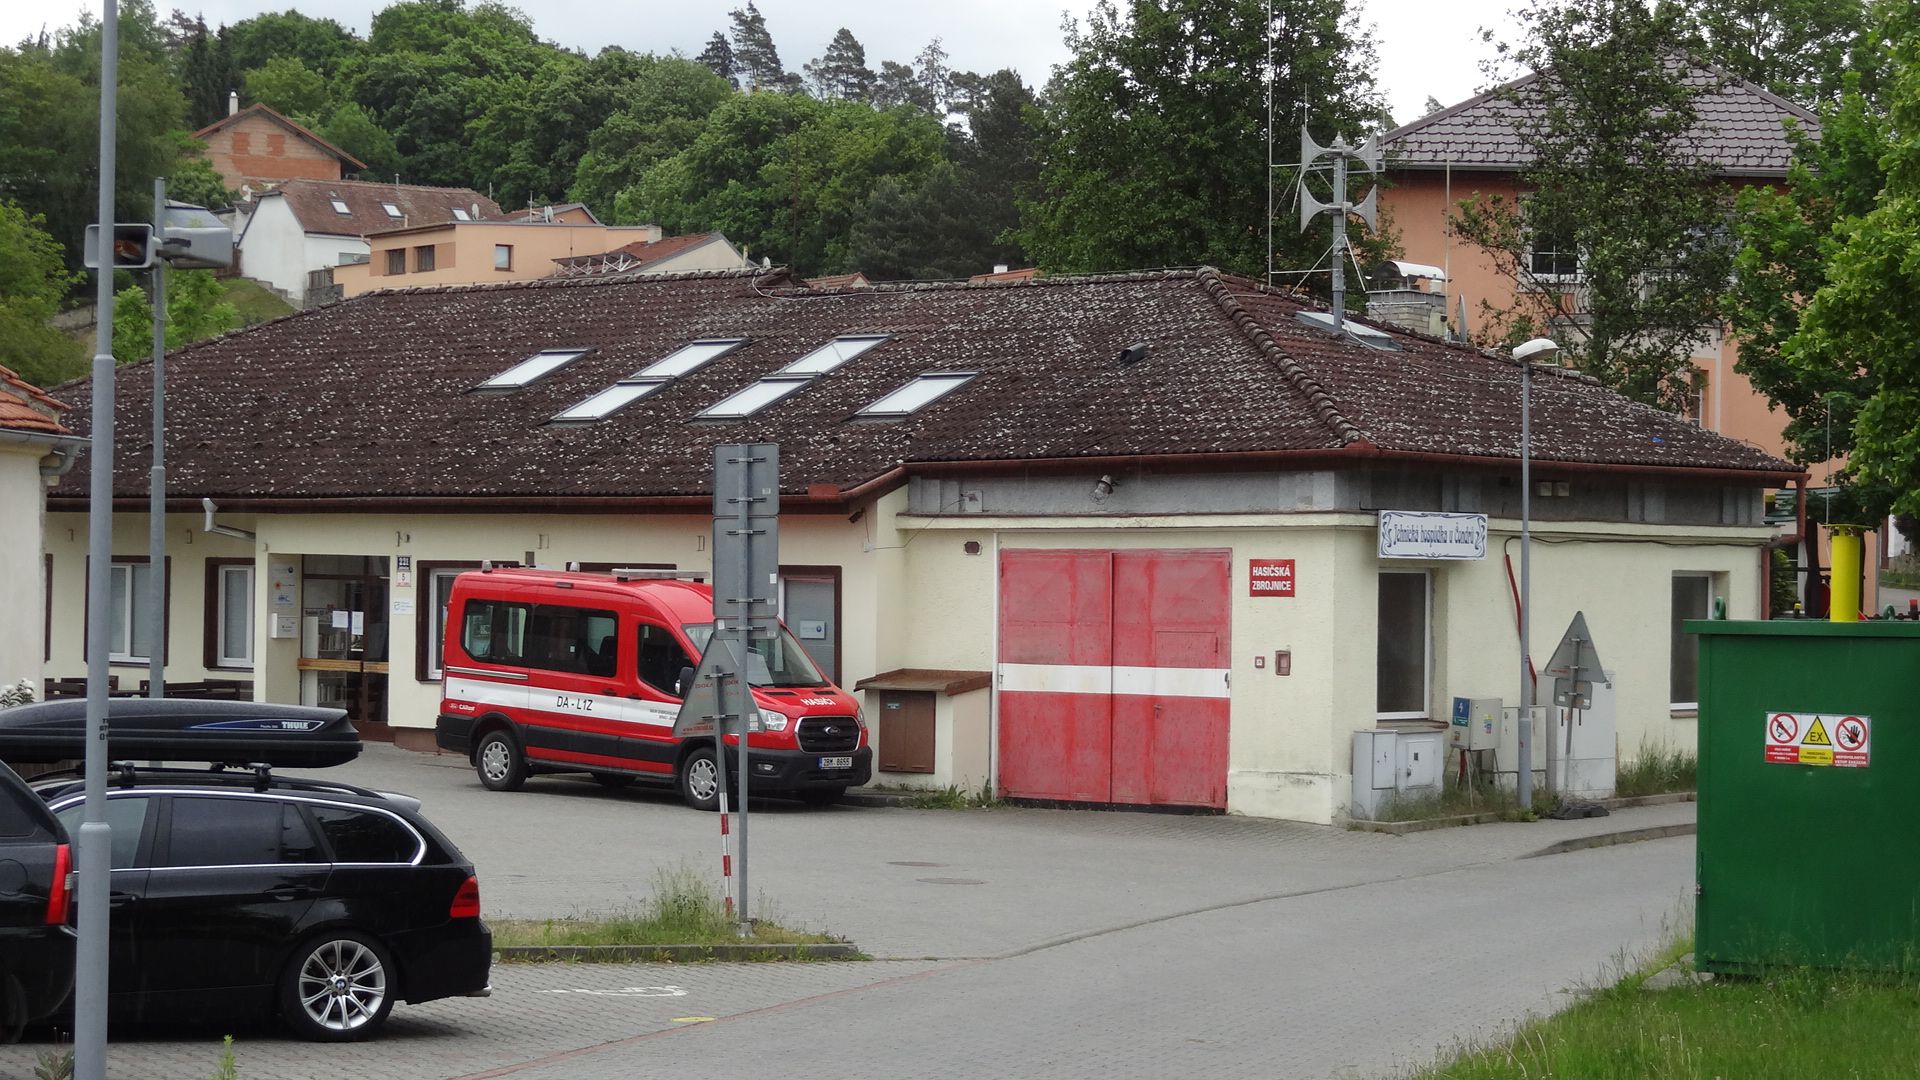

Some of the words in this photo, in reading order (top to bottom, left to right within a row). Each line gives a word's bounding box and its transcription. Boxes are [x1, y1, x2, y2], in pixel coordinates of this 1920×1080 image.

[1252, 564, 1291, 577] HASIČSKÁ
[1252, 580, 1291, 591] ZBROJNICE
[556, 695, 569, 708] DA
[281, 721, 309, 729] THULE
[1810, 731, 1823, 742] EX
